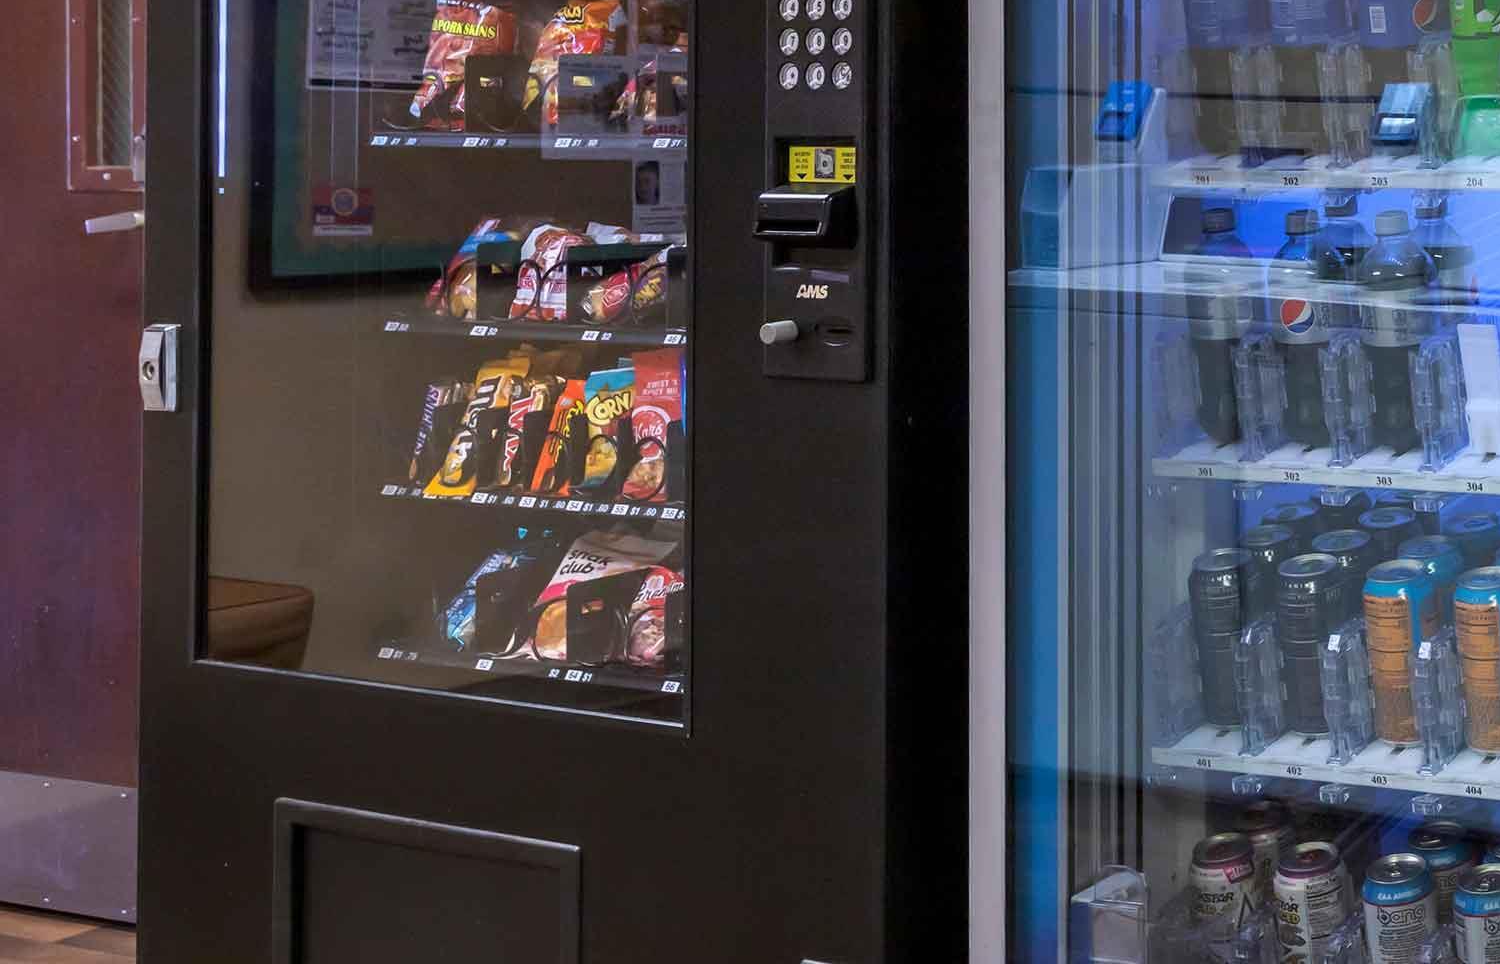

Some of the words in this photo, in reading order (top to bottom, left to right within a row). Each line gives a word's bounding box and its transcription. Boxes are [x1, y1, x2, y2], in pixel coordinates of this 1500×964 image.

[438, 20, 463, 35] PORK
[463, 23, 497, 39] SKINS
[1283, 176, 1299, 186] 202
[1466, 177, 1483, 187] 204
[796, 284, 829, 299] AMS
[1284, 472, 1300, 482] 302
[1376, 476, 1392, 486] 303
[1466, 482, 1484, 492] 304
[560, 561, 595, 575] club
[1371, 775, 1388, 785] 403
[1465, 786, 1482, 796] 404
